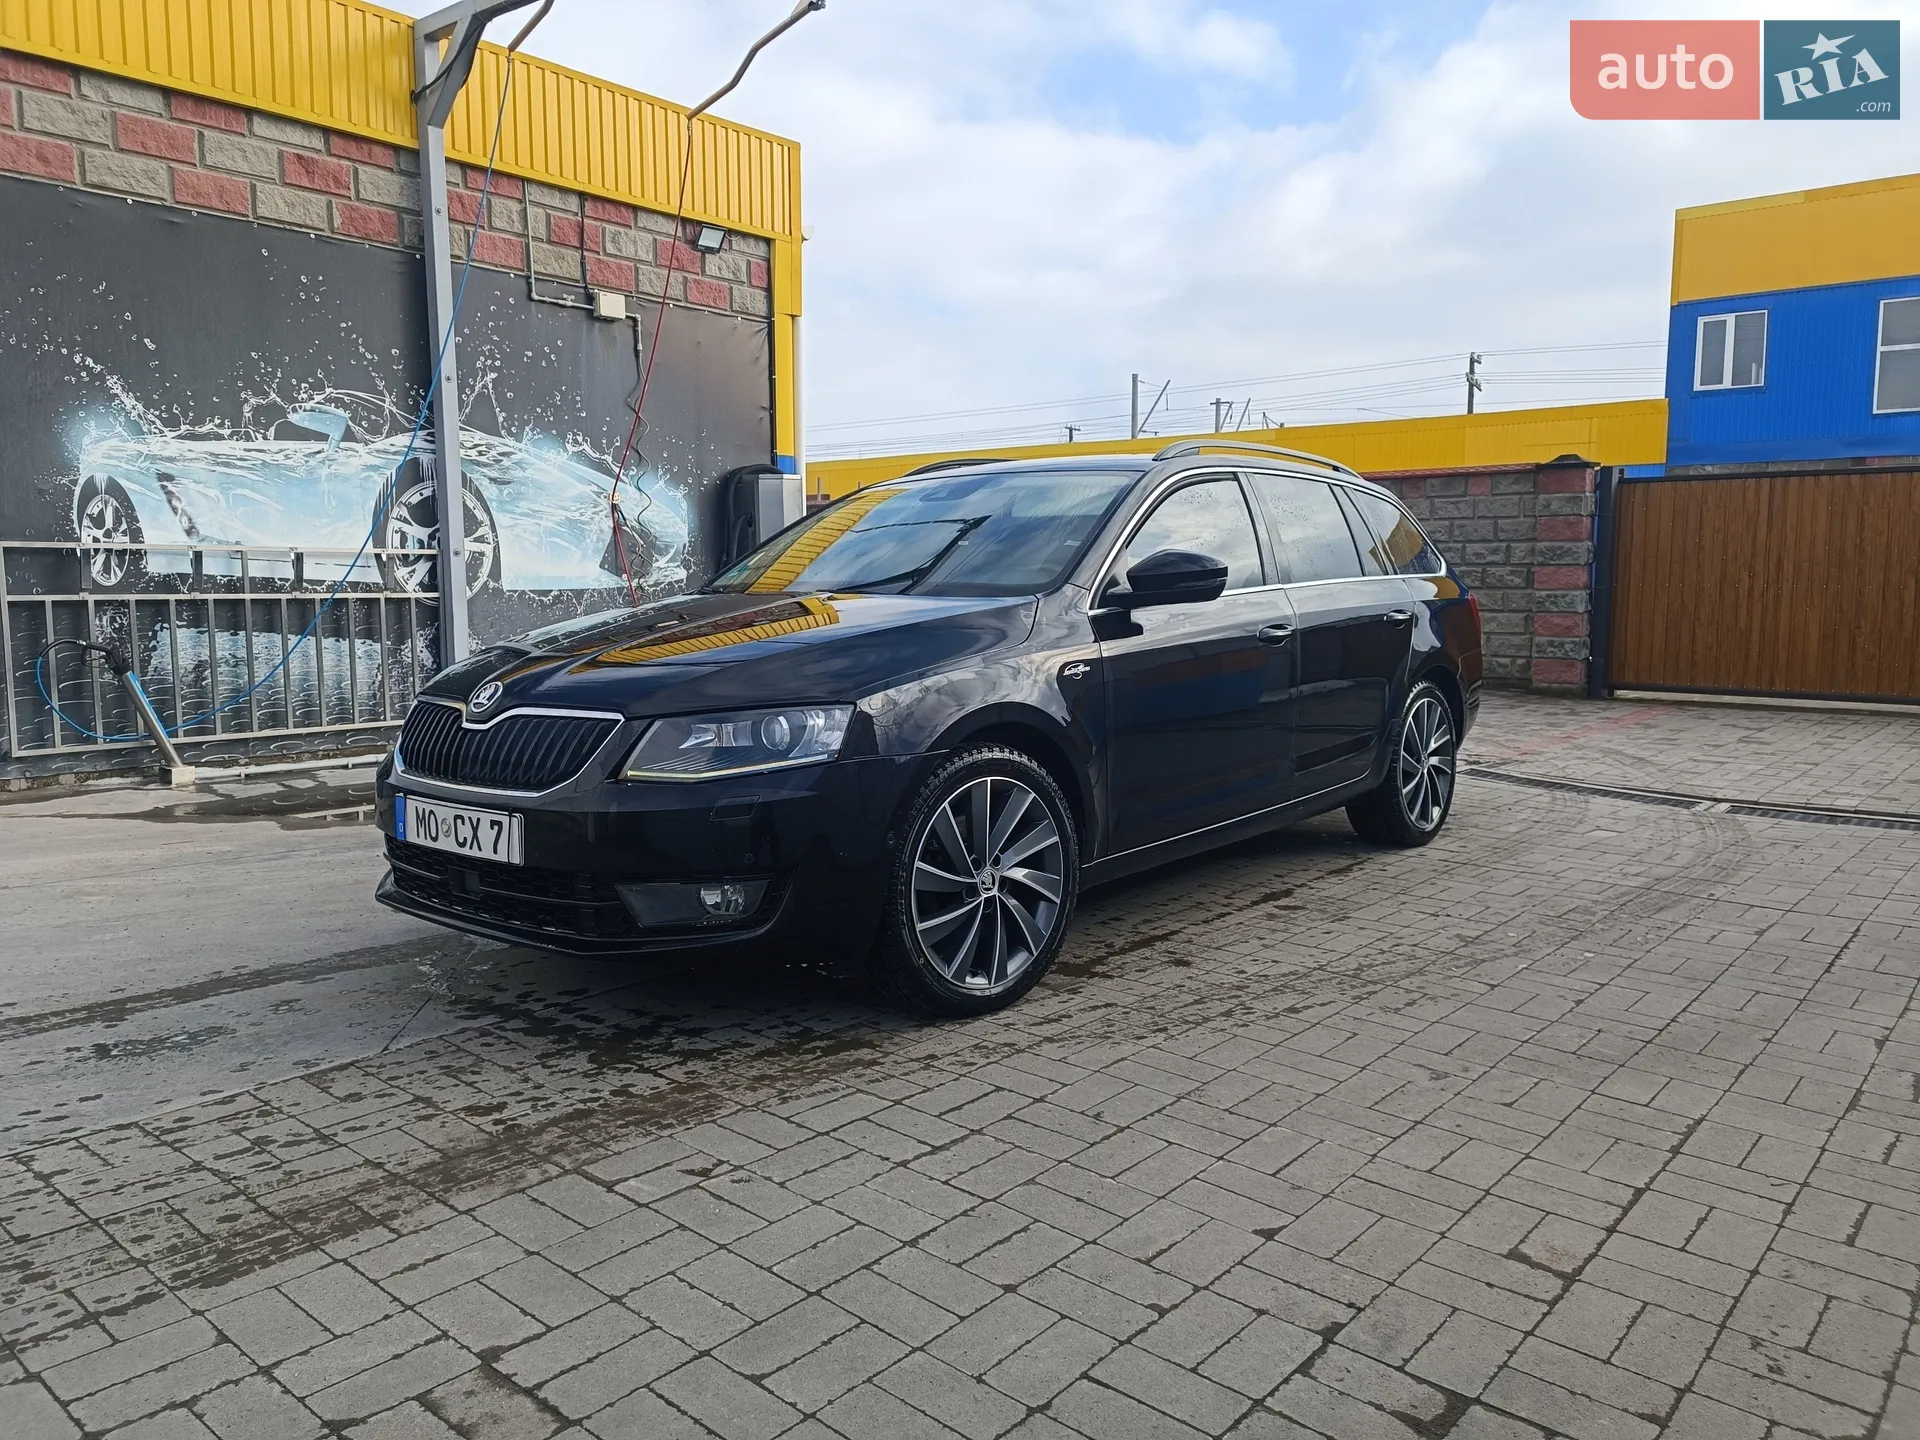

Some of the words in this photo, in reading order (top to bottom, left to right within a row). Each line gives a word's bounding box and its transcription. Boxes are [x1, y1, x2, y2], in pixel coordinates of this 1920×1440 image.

[414, 804, 440, 843] MO
[453, 813, 483, 852] CX
[489, 818, 504, 856] 7
